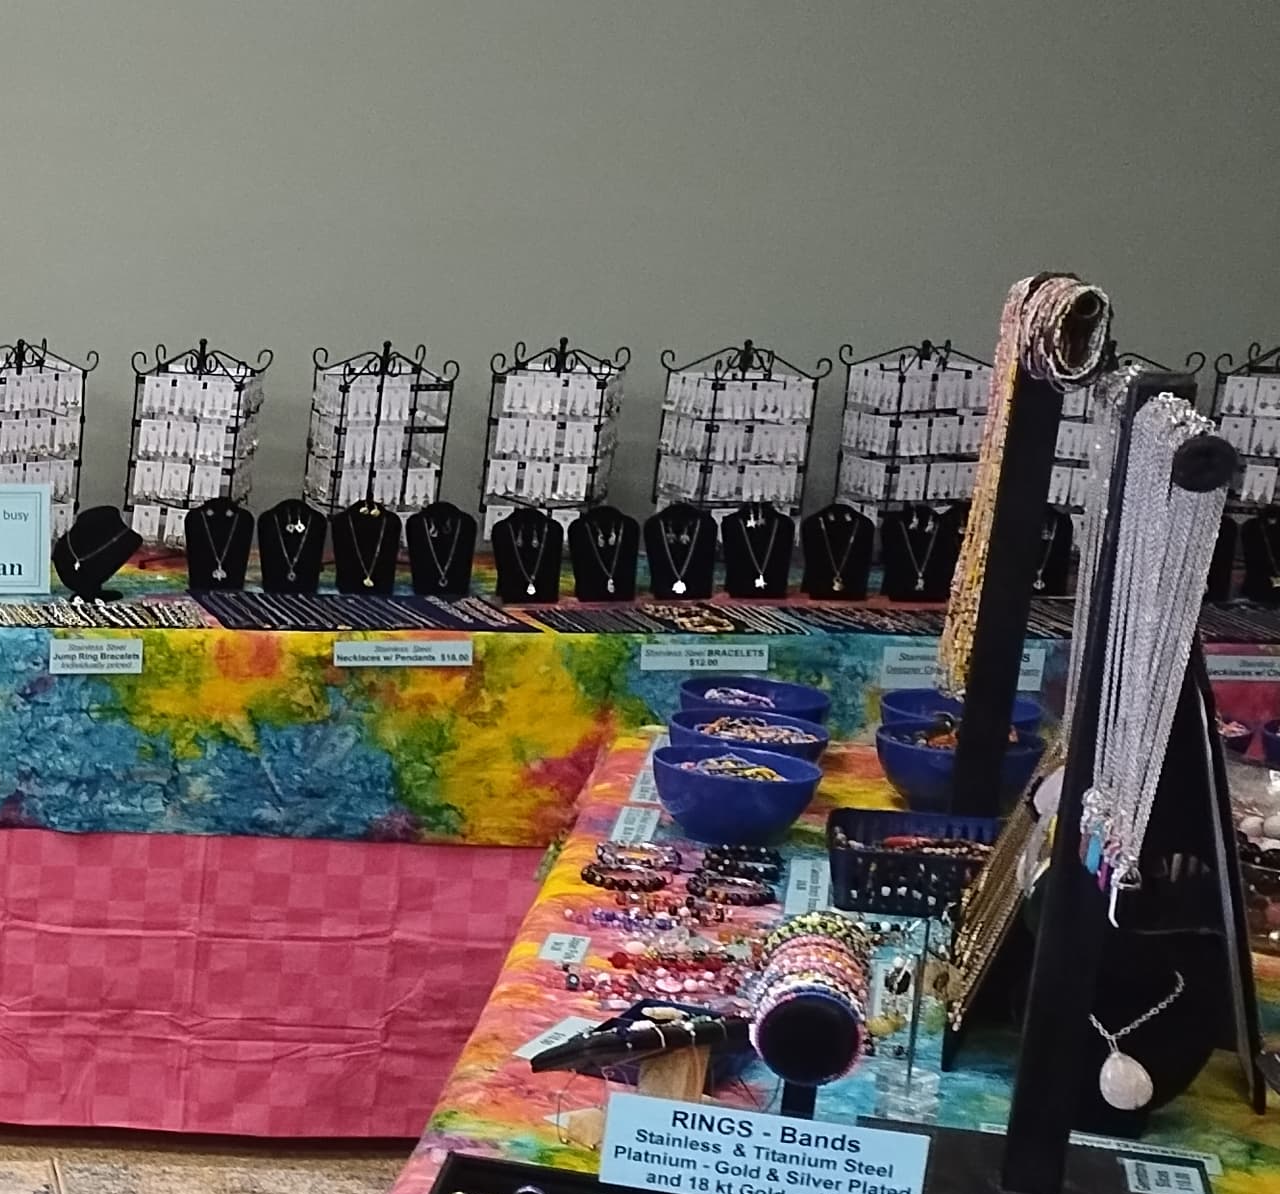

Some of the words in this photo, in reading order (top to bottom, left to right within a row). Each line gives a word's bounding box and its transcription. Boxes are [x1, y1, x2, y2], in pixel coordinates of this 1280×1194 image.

[3, 509, 29, 522] busy
[54, 653, 77, 661] Jump
[78, 653, 98, 661] Ring
[337, 654, 381, 662] Necklaces
[671, 1110, 754, 1138] RINGS
[780, 1126, 861, 1153] Bands
[635, 1128, 722, 1154] Stainless
[732, 1143, 745, 1157] &
[753, 1145, 837, 1171] Titanium
[843, 1158, 894, 1178] Steel
[614, 1145, 697, 1170] Platnium
[714, 1161, 760, 1180] Gold
[766, 1168, 779, 1182] &
[786, 1170, 842, 1192] Silver
[646, 1171, 682, 1188] and
[689, 1177, 709, 1191] 18
